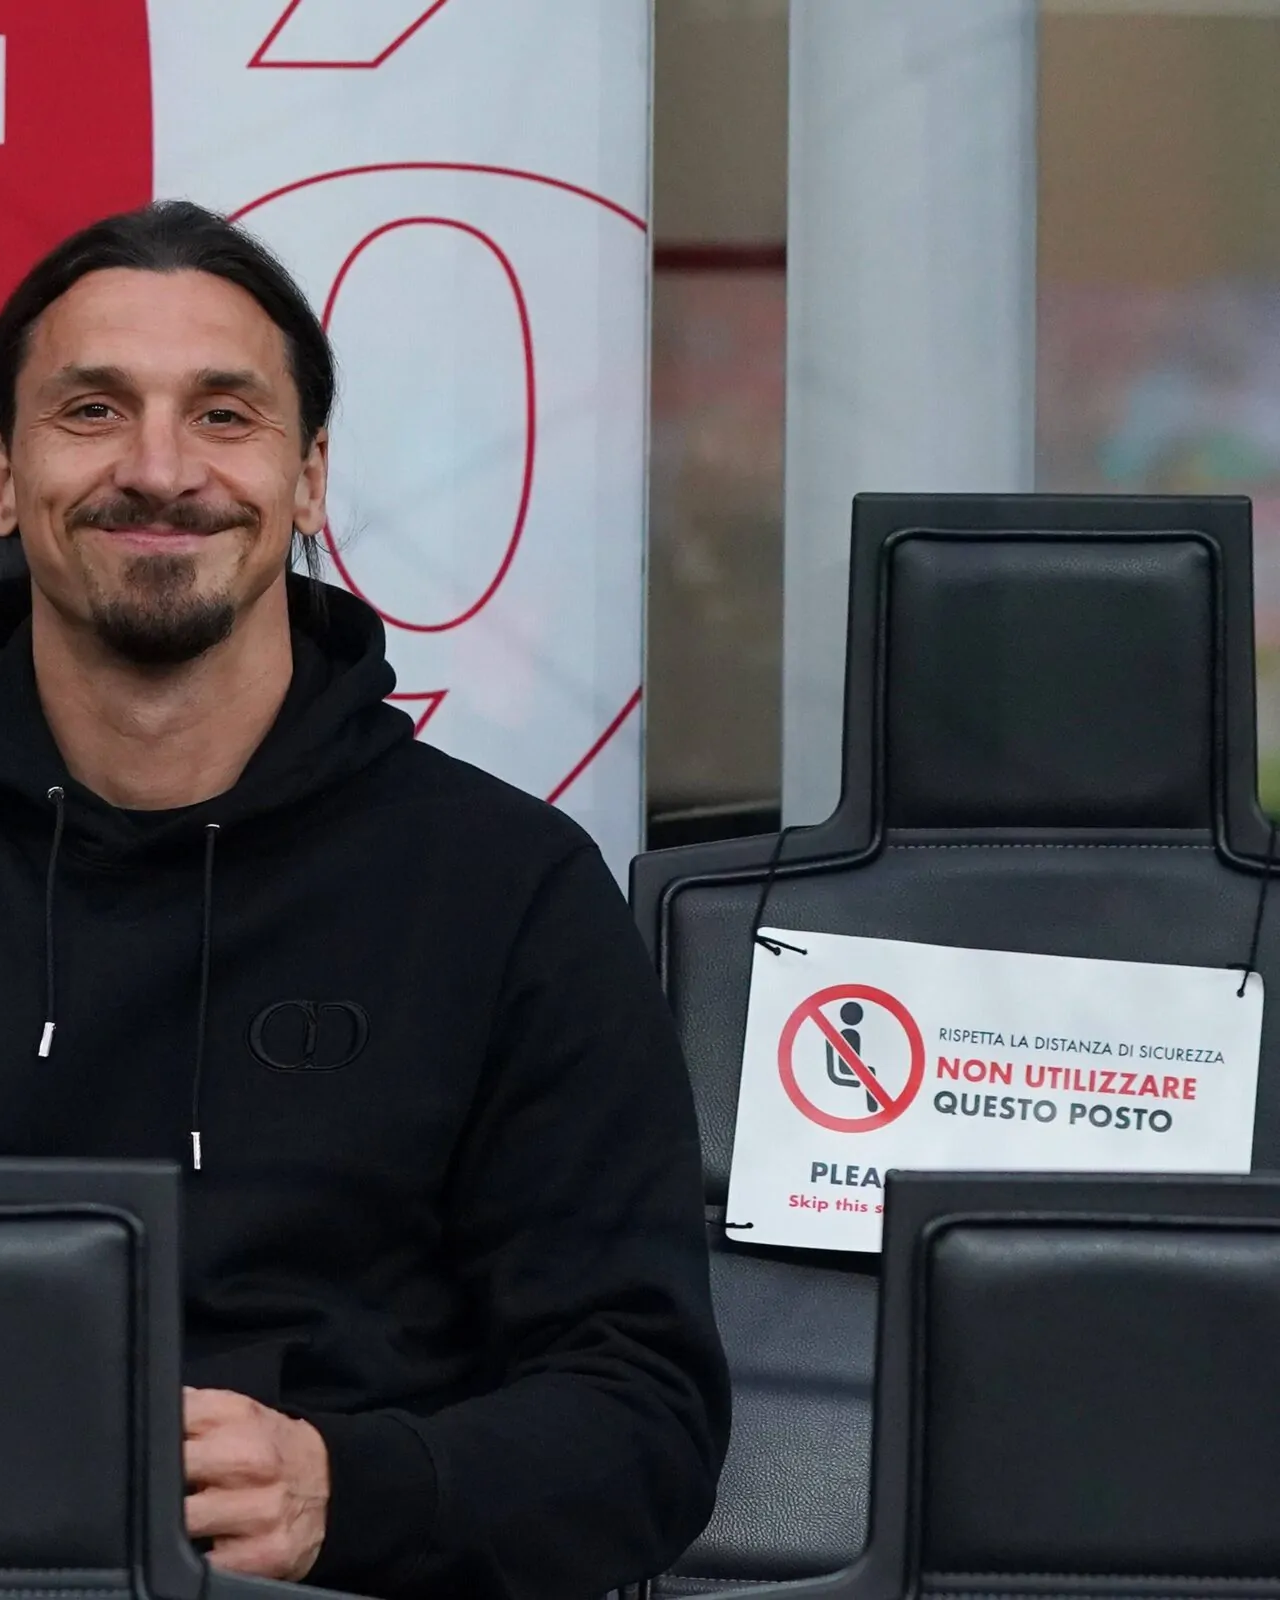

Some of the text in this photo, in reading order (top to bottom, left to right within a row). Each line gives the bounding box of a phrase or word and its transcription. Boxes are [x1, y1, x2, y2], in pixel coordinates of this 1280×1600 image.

[938, 1027, 1225, 1065] RISPETTA LA DISTANZA DI SICUREZZA
[936, 1055, 1197, 1102] NON UTILIZZARE
[933, 1090, 1173, 1134] QUESTO POSTO
[810, 1161, 883, 1189] PLEA
[788, 1194, 829, 1213] Skip
[835, 1198, 869, 1213] this
